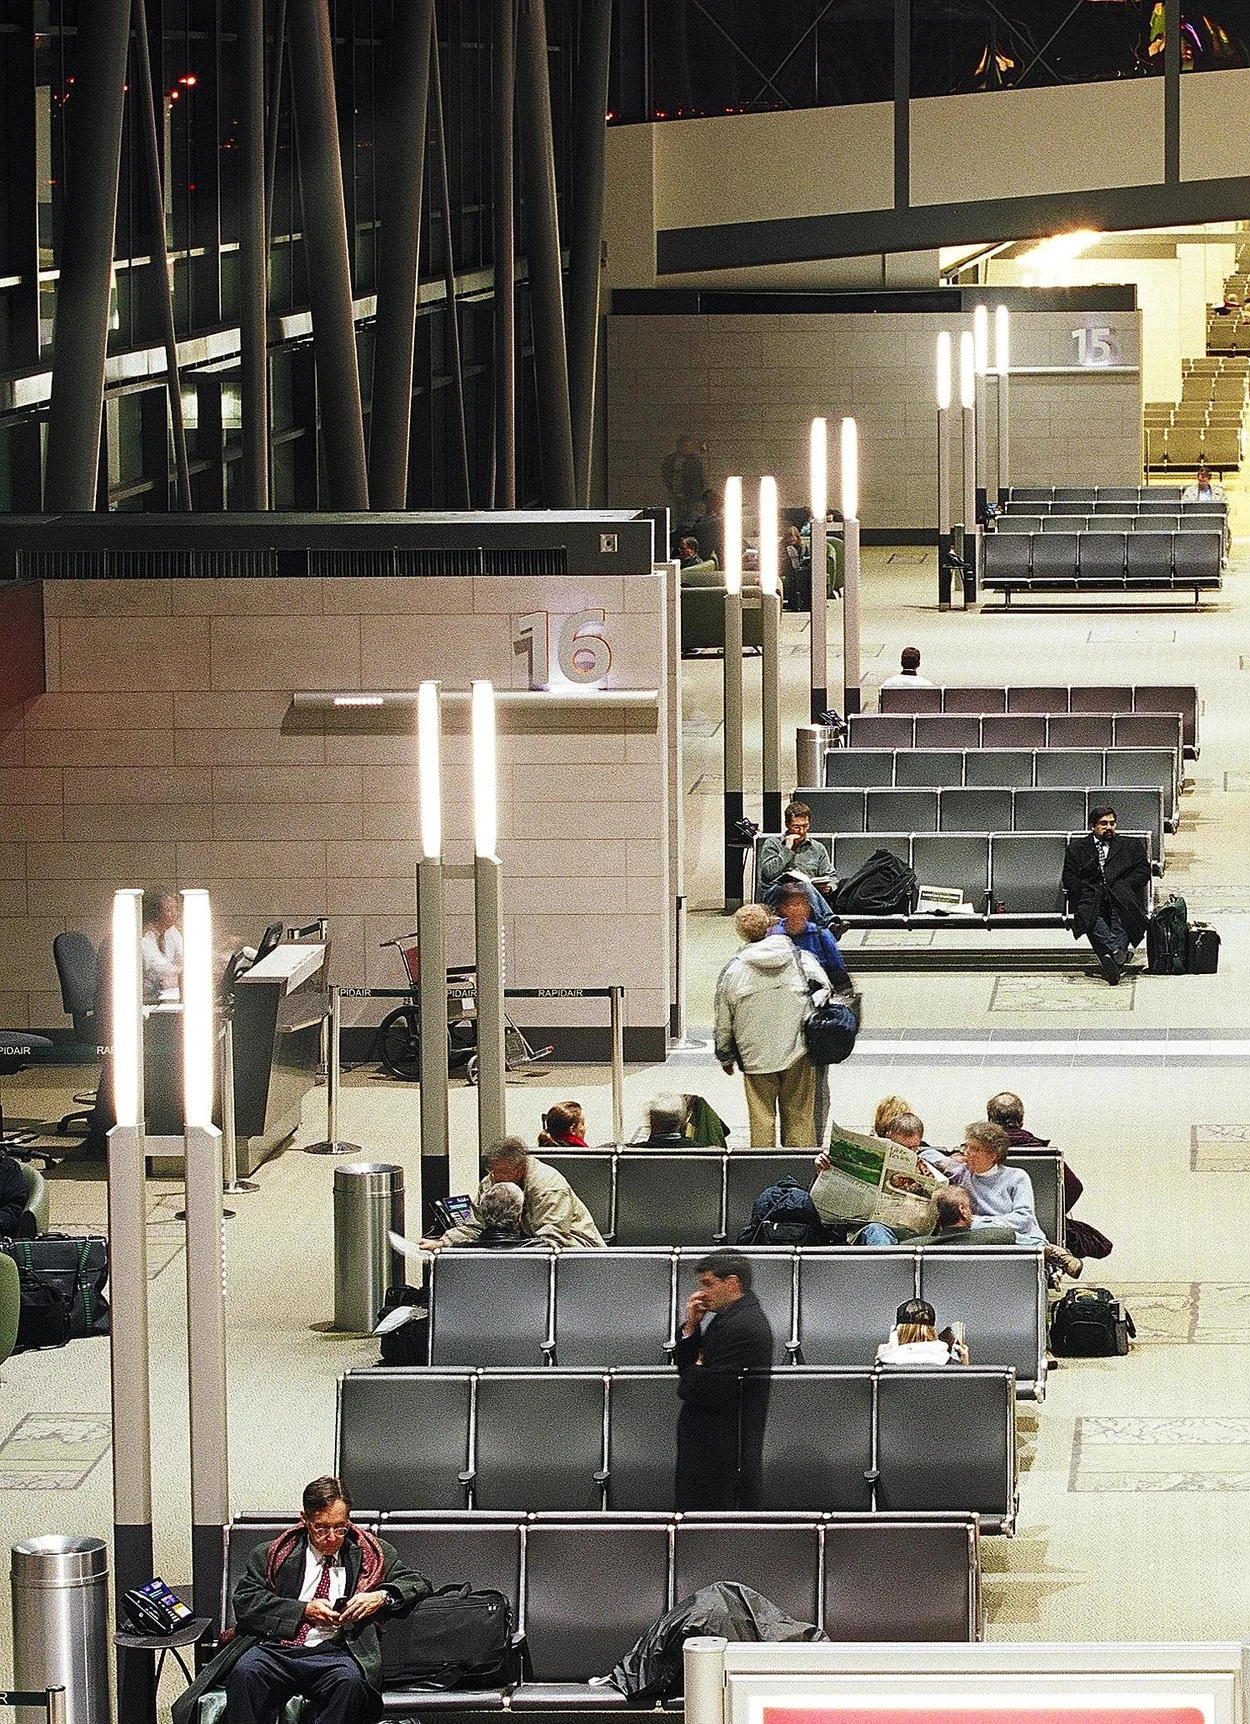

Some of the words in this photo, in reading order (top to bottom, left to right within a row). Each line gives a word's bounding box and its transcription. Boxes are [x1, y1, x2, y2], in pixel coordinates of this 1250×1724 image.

[1071, 328, 1111, 366] 15
[517, 608, 612, 684] 16
[537, 989, 583, 997] RAPIDAIR
